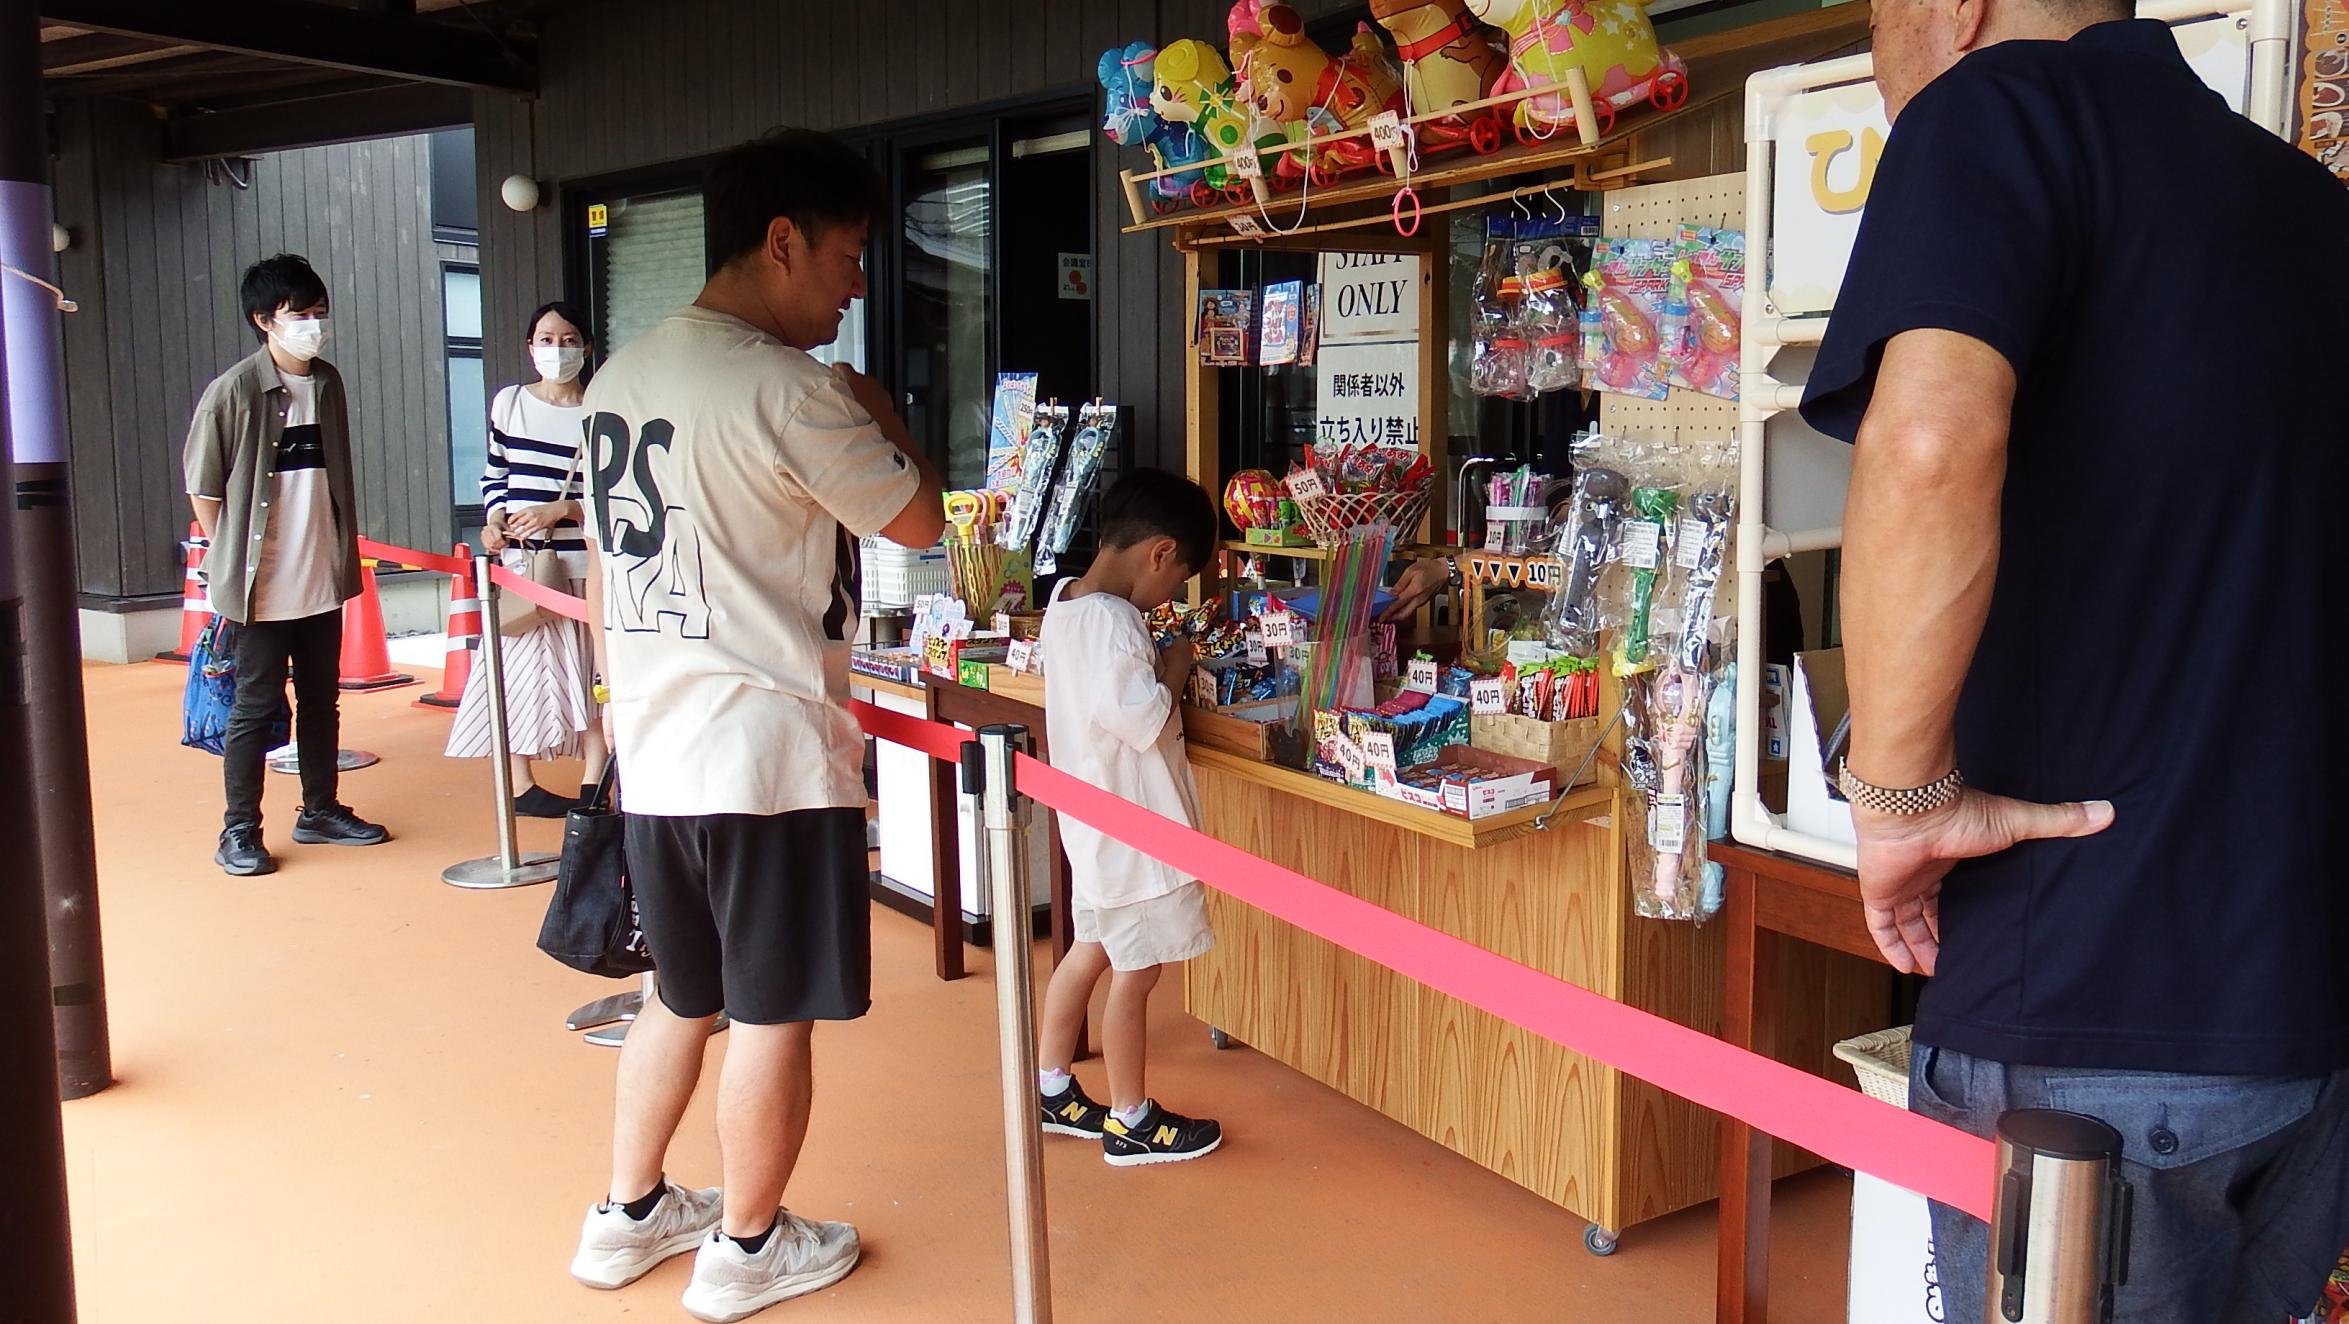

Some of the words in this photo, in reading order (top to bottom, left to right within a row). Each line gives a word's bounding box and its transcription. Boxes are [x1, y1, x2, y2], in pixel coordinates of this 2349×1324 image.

[1337, 280, 1409, 318] ONLY
[1333, 372, 1405, 398] 関係者以外
[1319, 416, 1419, 446] 立ち入り禁止
[1294, 478, 1319, 496] 50円
[1527, 562, 1562, 586] 10円
[1264, 622, 1288, 638] 30円
[1249, 639, 1264, 653] 30円
[1011, 647, 1027, 665] 40円
[1412, 669, 1433, 685] 40円
[1476, 688, 1500, 705] 40円
[1339, 743, 1361, 771] 40円
[1367, 742, 1390, 759] 40円
[1400, 789, 1422, 804] ビスコ
[1060, 1100, 1088, 1122] N
[1152, 1124, 1179, 1147] N
